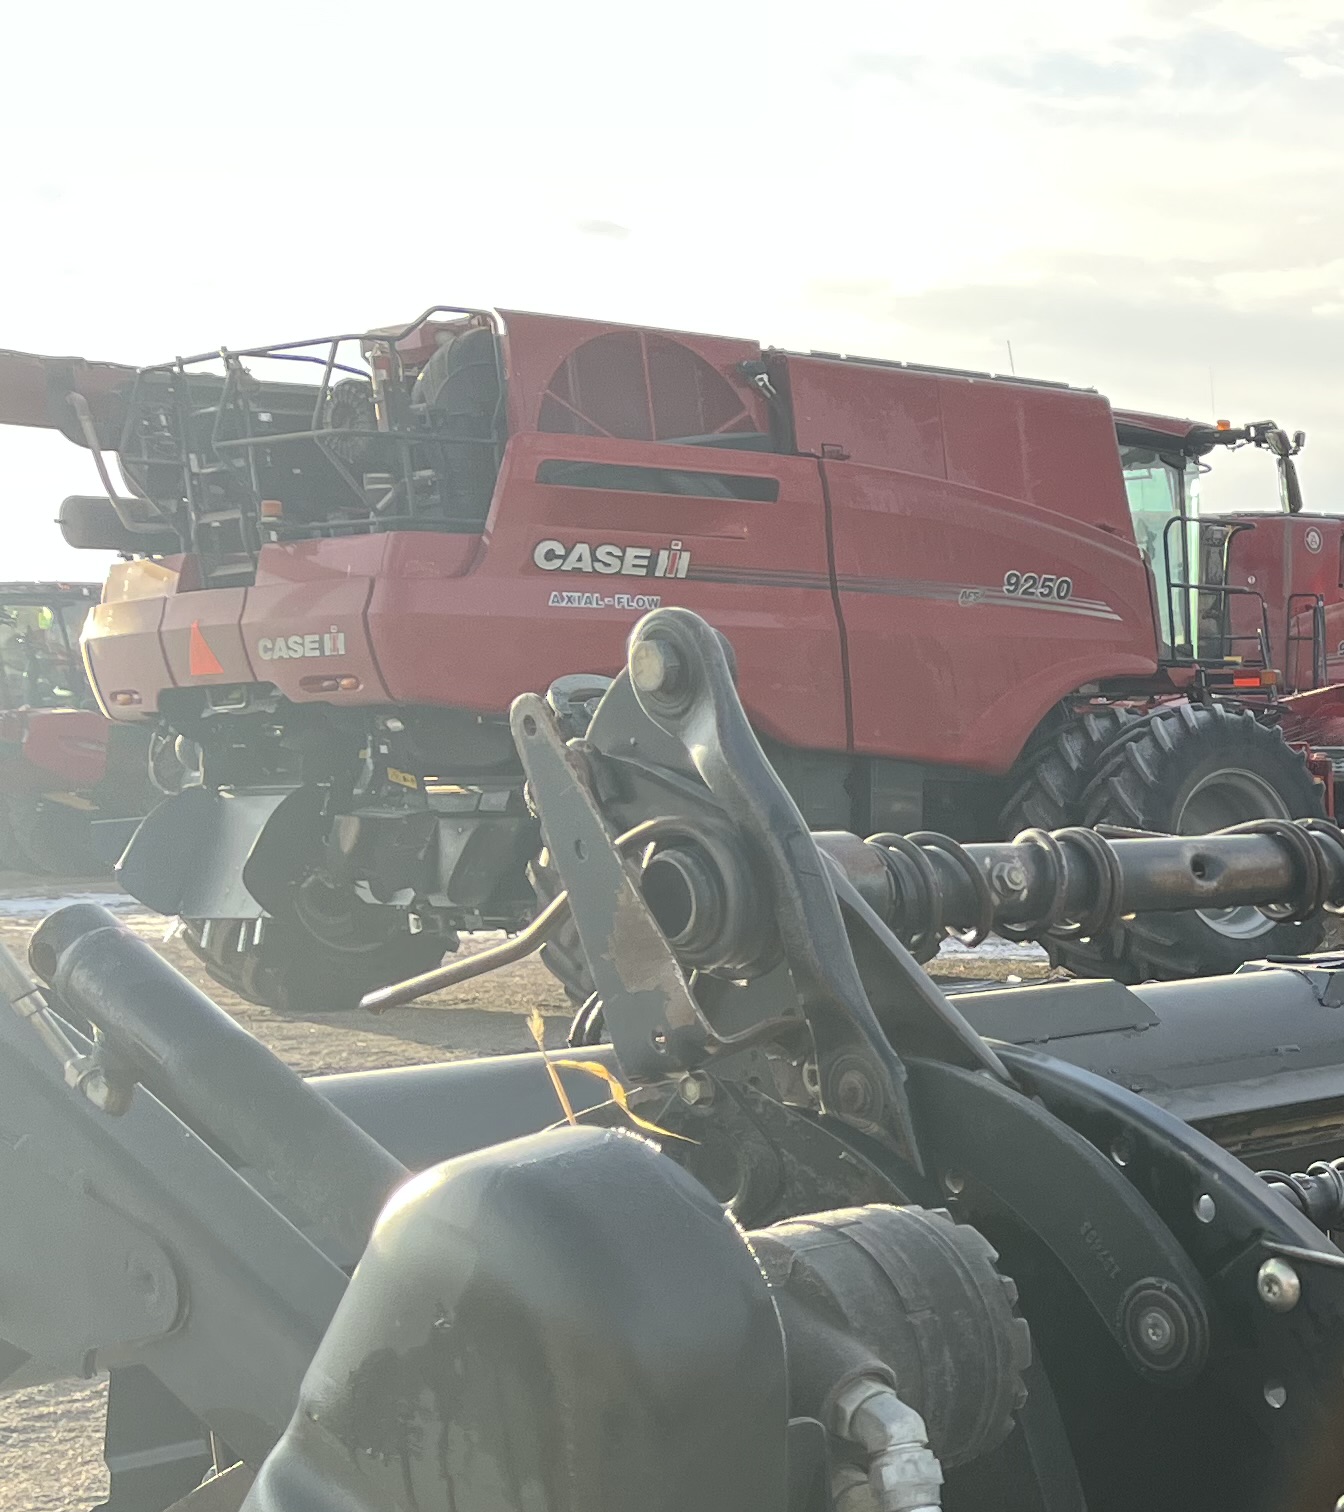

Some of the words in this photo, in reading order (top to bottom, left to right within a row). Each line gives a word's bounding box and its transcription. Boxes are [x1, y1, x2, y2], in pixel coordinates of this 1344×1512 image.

[534, 540, 651, 576] CASE
[1003, 570, 1072, 601] 9250
[549, 592, 661, 609] AXIAL-FLOW
[258, 634, 321, 660] CASE
